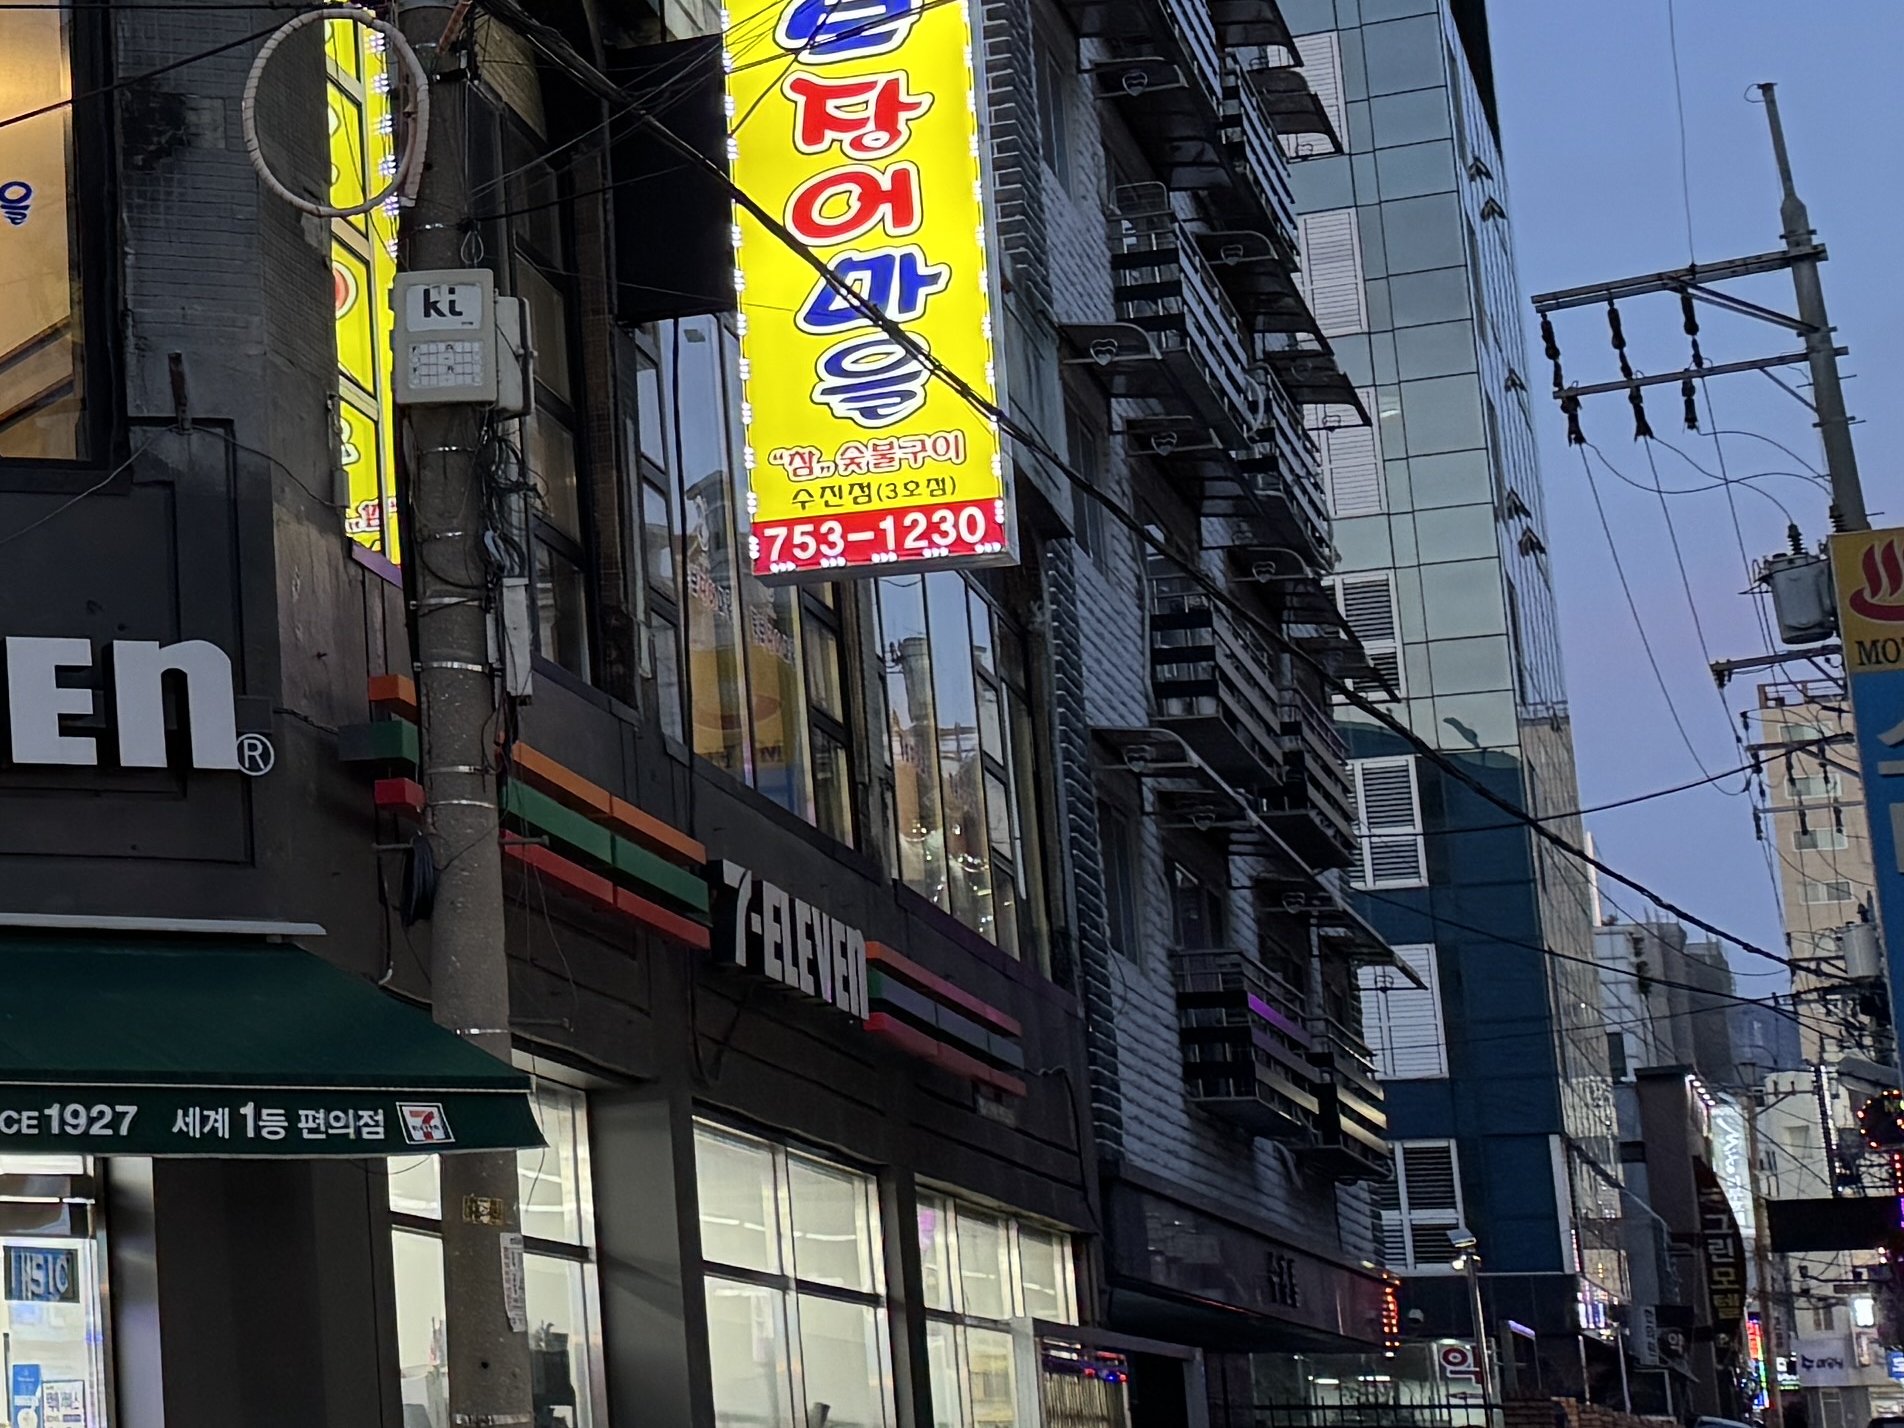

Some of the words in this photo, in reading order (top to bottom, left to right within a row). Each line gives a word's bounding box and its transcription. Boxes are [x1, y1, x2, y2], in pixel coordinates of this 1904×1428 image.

[837, 432, 966, 475] 숯불구이
[763, 506, 987, 563] 753-1230
[1856, 638, 1904, 667] MO
[43, 1102, 138, 1138] 1927
[171, 1107, 230, 1140] 세계
[239, 1101, 289, 1141] 1등
[296, 1107, 386, 1141] 편의점
